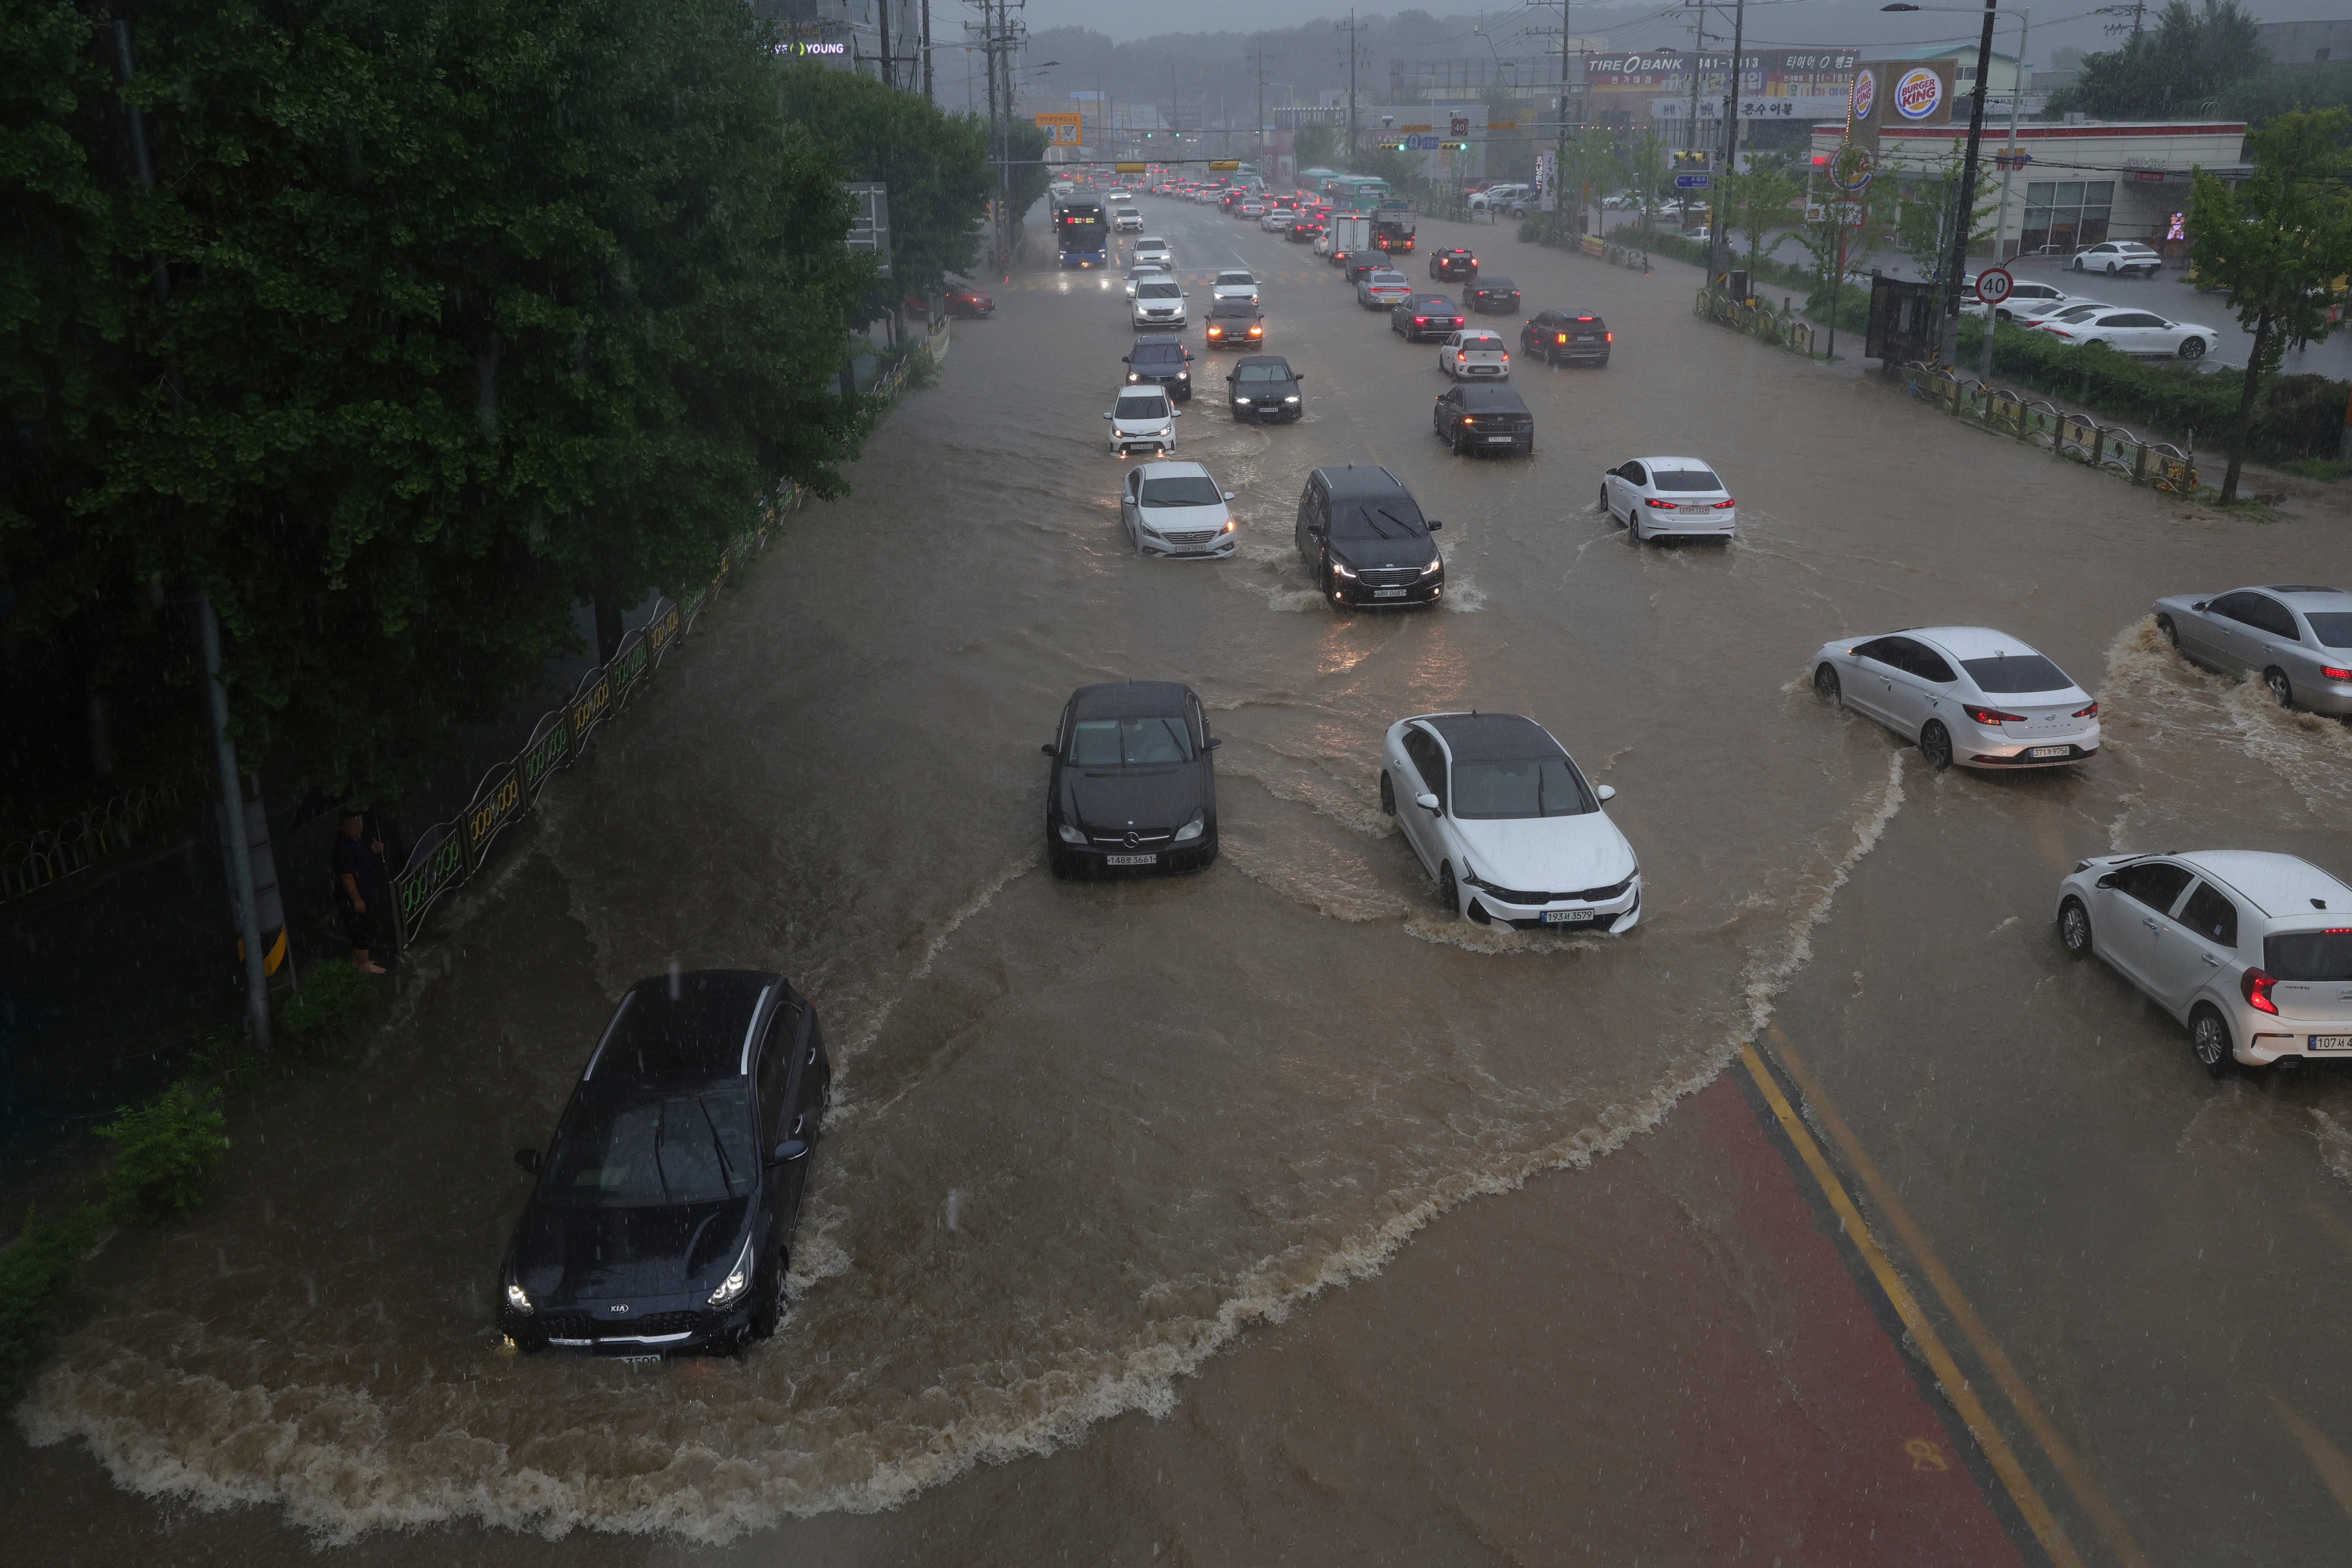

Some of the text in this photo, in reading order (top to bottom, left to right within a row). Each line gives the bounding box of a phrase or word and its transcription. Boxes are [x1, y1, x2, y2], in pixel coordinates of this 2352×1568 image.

[806, 44, 843, 54] YOUNG
[1589, 60, 1622, 71] TIRE
[1641, 59, 1683, 69] BANK
[1786, 56, 1816, 69] 타이어
[1835, 56, 1854, 69] 뱅크
[1857, 80, 1871, 96] BURGER
[1902, 79, 1935, 96] BURGER
[1856, 88, 1871, 106] KING
[1902, 87, 1936, 107] KING
[1455, 122, 1465, 131] 40
[1984, 278, 2005, 293] 40
[1133, 855, 1153, 864] 3661
[1572, 911, 1592, 920] 3579
[2318, 1038, 2344, 1048] 107서
